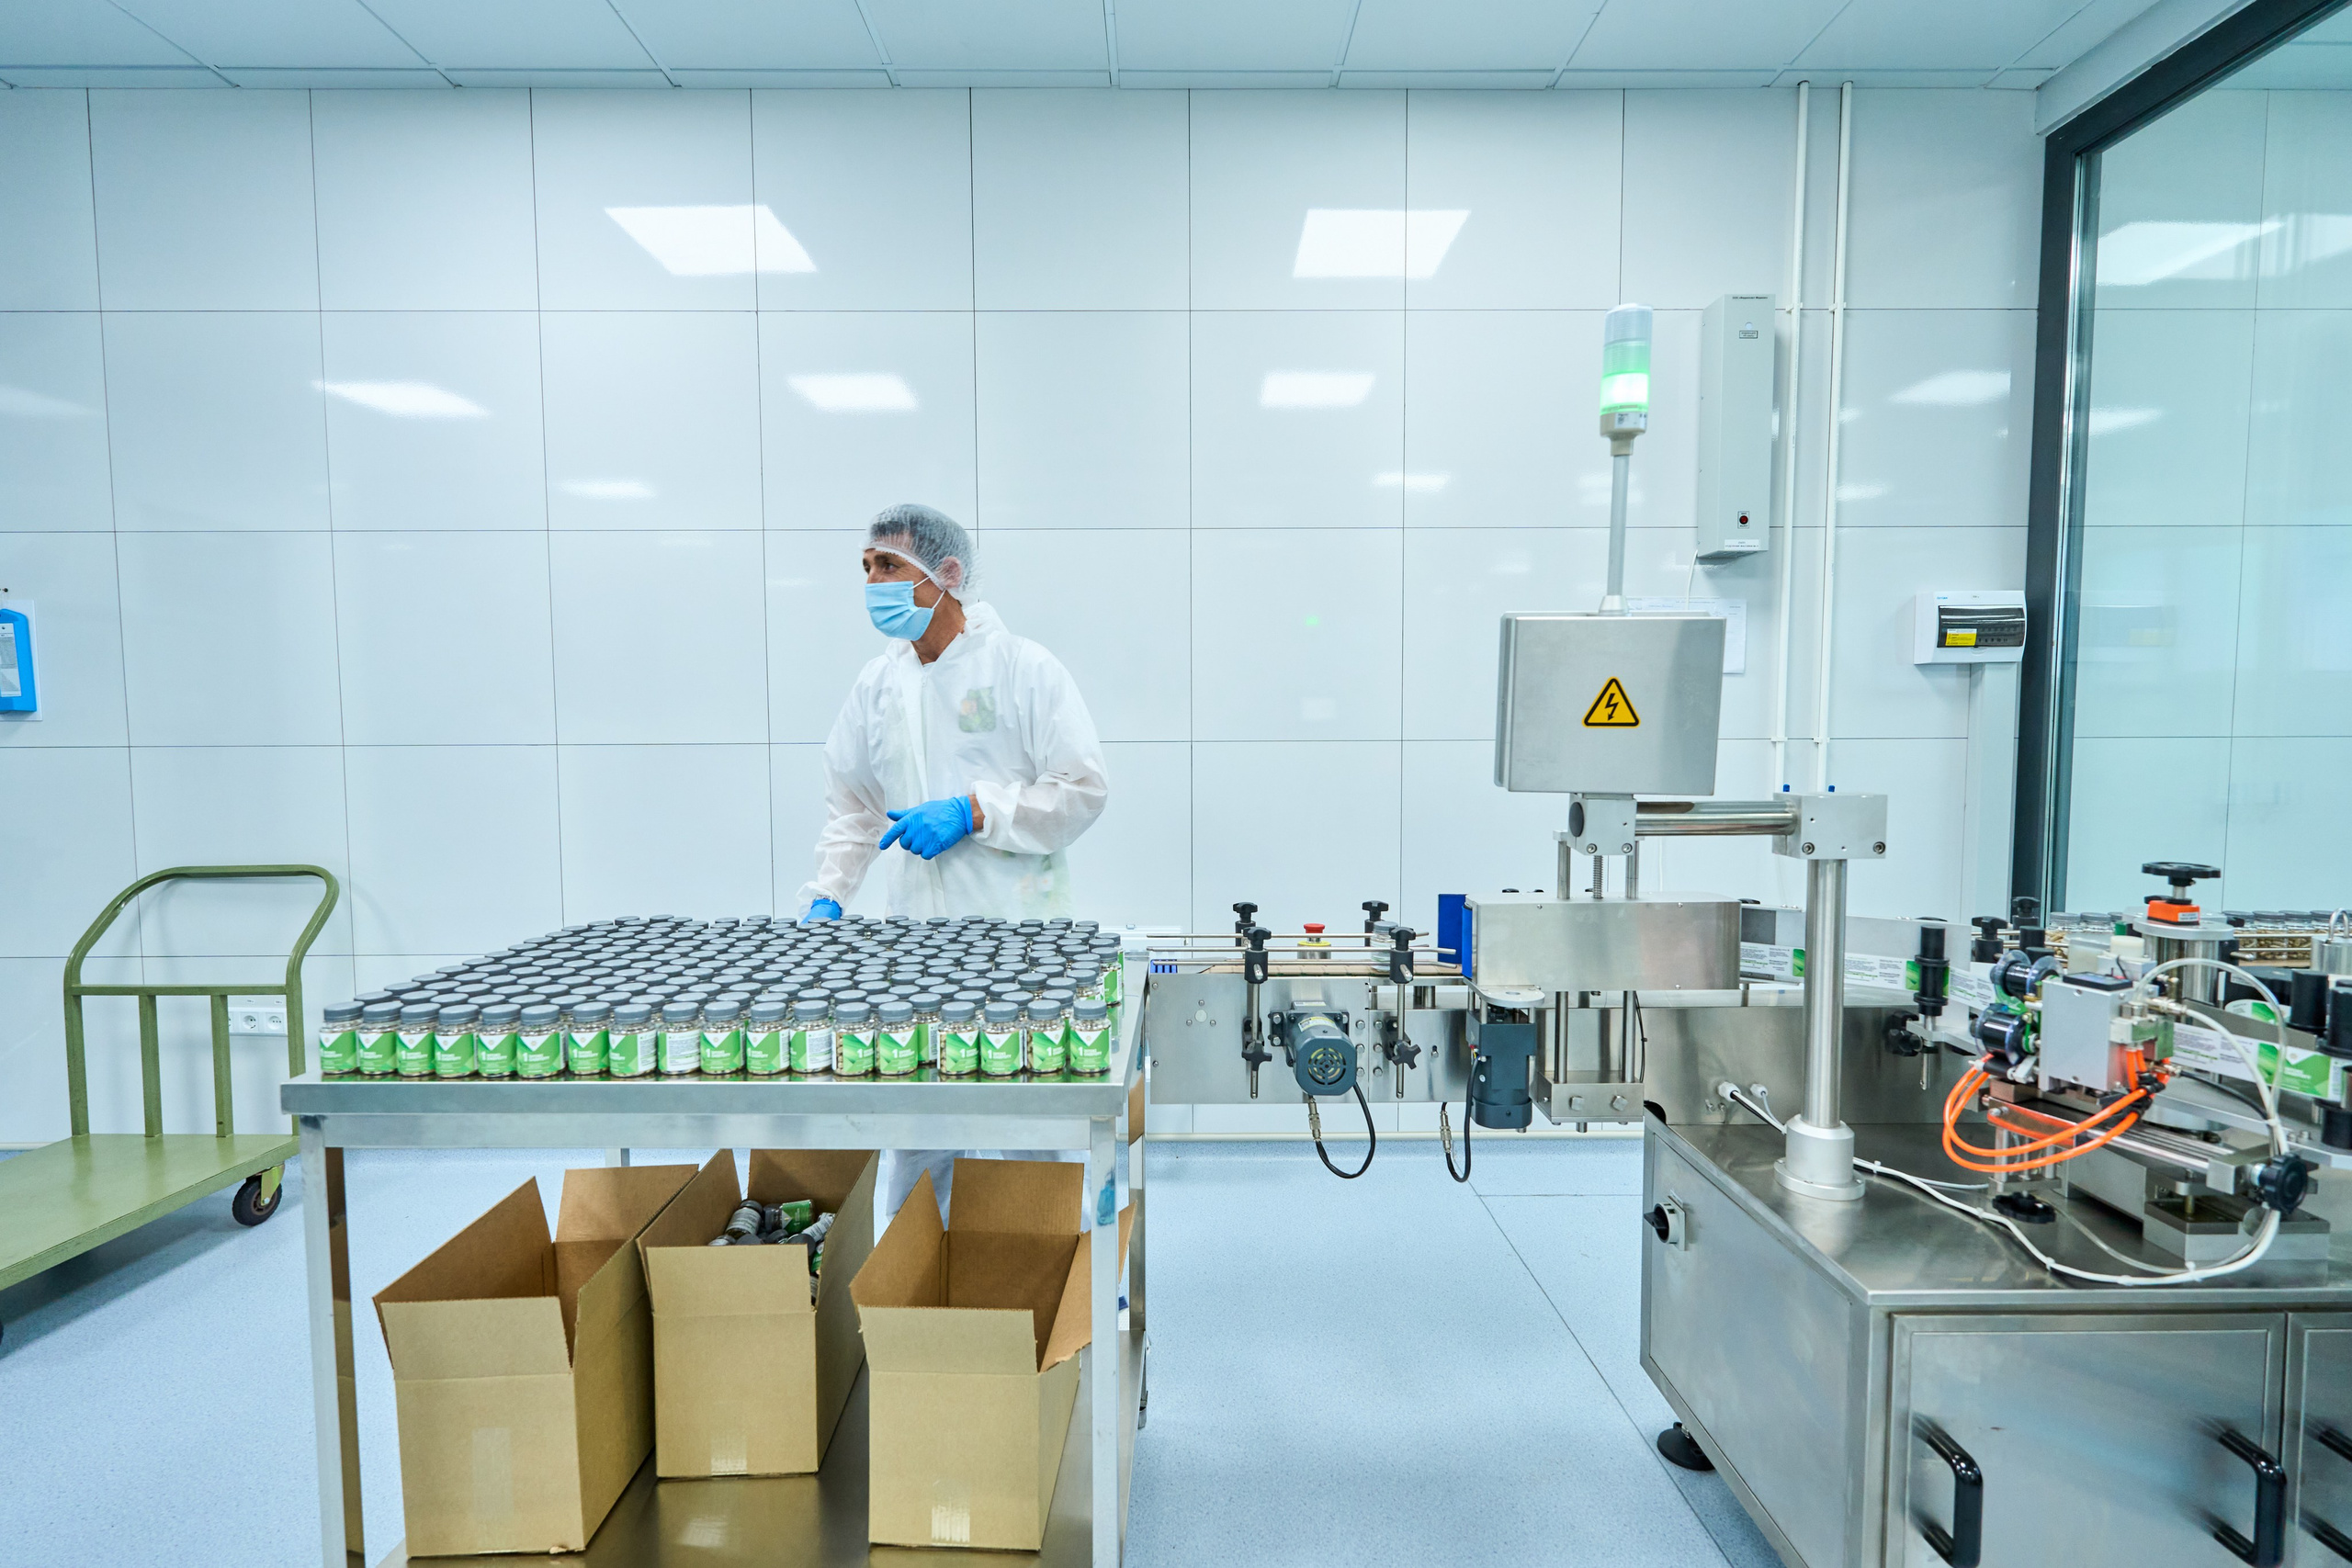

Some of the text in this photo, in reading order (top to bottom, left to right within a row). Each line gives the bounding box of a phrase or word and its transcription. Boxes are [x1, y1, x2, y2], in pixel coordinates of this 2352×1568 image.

[401, 1050, 406, 1059] 1
[436, 1051, 441, 1060] 1
[572, 1049, 578, 1058] 1
[706, 1048, 710, 1057] 1
[857, 1049, 863, 1058] 1
[892, 1049, 898, 1058] 1
[960, 1048, 966, 1058] 1
[988, 1049, 992, 1059] 1
[1046, 1047, 1052, 1056] 1
[1078, 1046, 1083, 1056] 1
[481, 1051, 486, 1061] 1
[523, 1052, 528, 1062] 1
